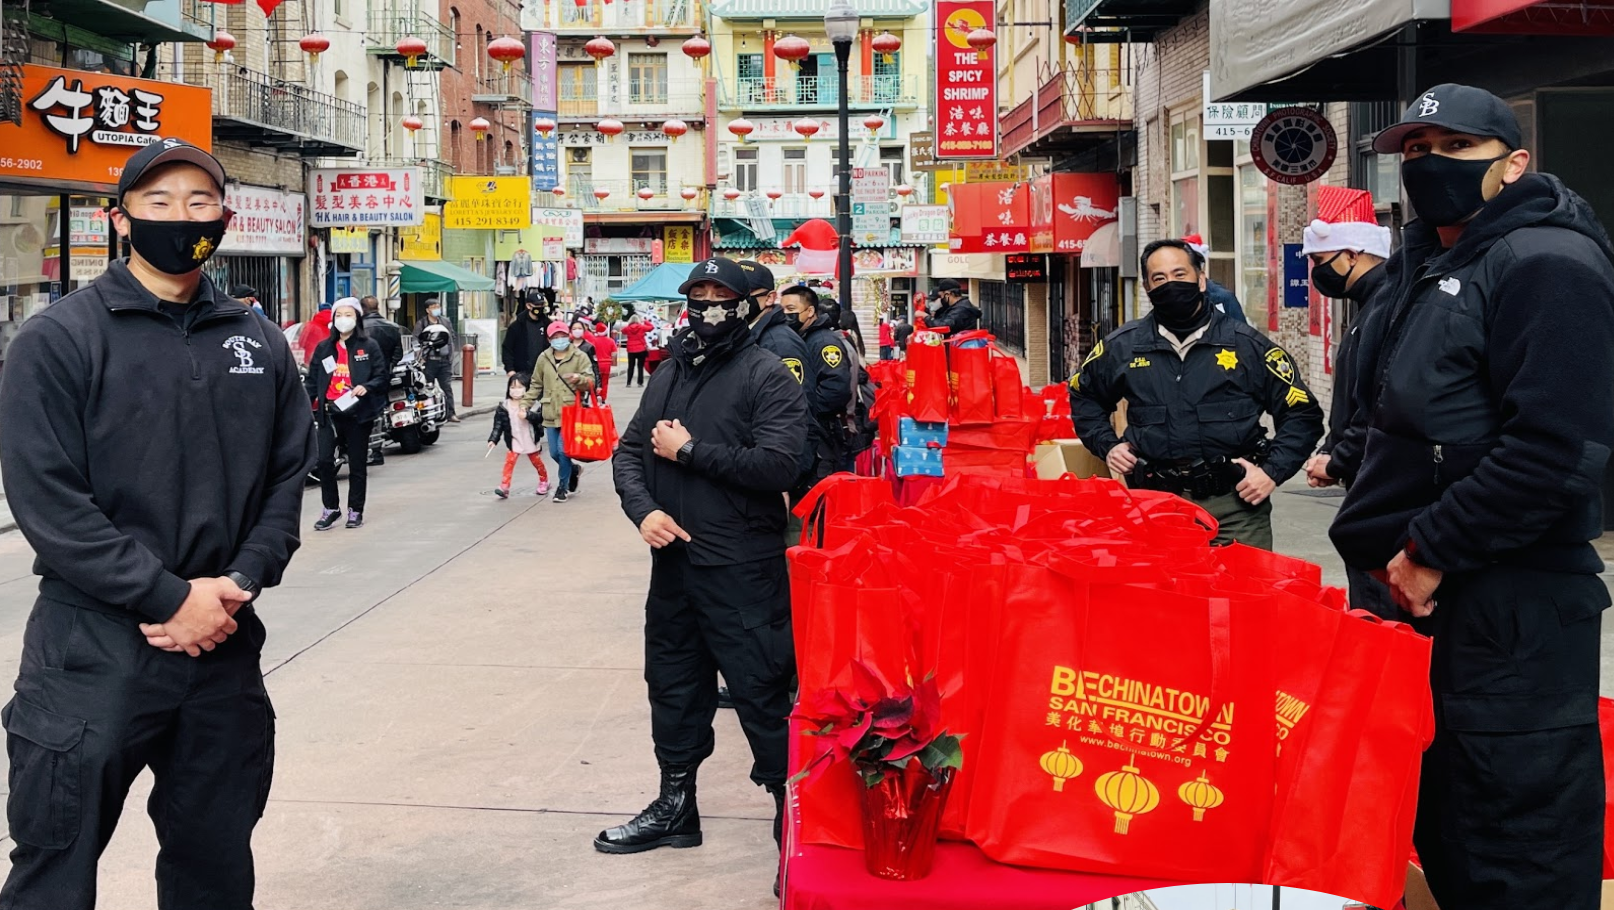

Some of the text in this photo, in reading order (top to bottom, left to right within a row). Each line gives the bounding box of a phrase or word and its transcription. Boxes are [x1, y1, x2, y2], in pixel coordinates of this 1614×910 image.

[954, 53, 978, 65] THE
[949, 71, 983, 82] SPICY
[944, 88, 989, 100] SHRIMP
[1419, 92, 1440, 117] SB
[32, 76, 164, 153] 牛麵王
[1207, 105, 1263, 119] 保險顧問
[943, 122, 990, 136] 茶餐廳
[1252, 119, 1271, 152] CHINATOWN
[97, 133, 134, 144] UTOPIA
[1322, 125, 1336, 150] SOCIETY
[853, 168, 864, 178] NO
[348, 175, 378, 187] 香港
[315, 195, 413, 210] 髮型美容中心
[855, 205, 863, 213] 2
[315, 212, 413, 222] HK HAIR & BEAUTY SALON
[239, 216, 245, 232] &
[247, 217, 274, 233] BEAUTY
[275, 219, 296, 234] SALON
[984, 232, 1026, 246] 茶餐廳
[222, 335, 262, 349] SOUTH BAY
[232, 341, 254, 367] SB
[1049, 696, 1231, 745] SAN FRANCISCO
